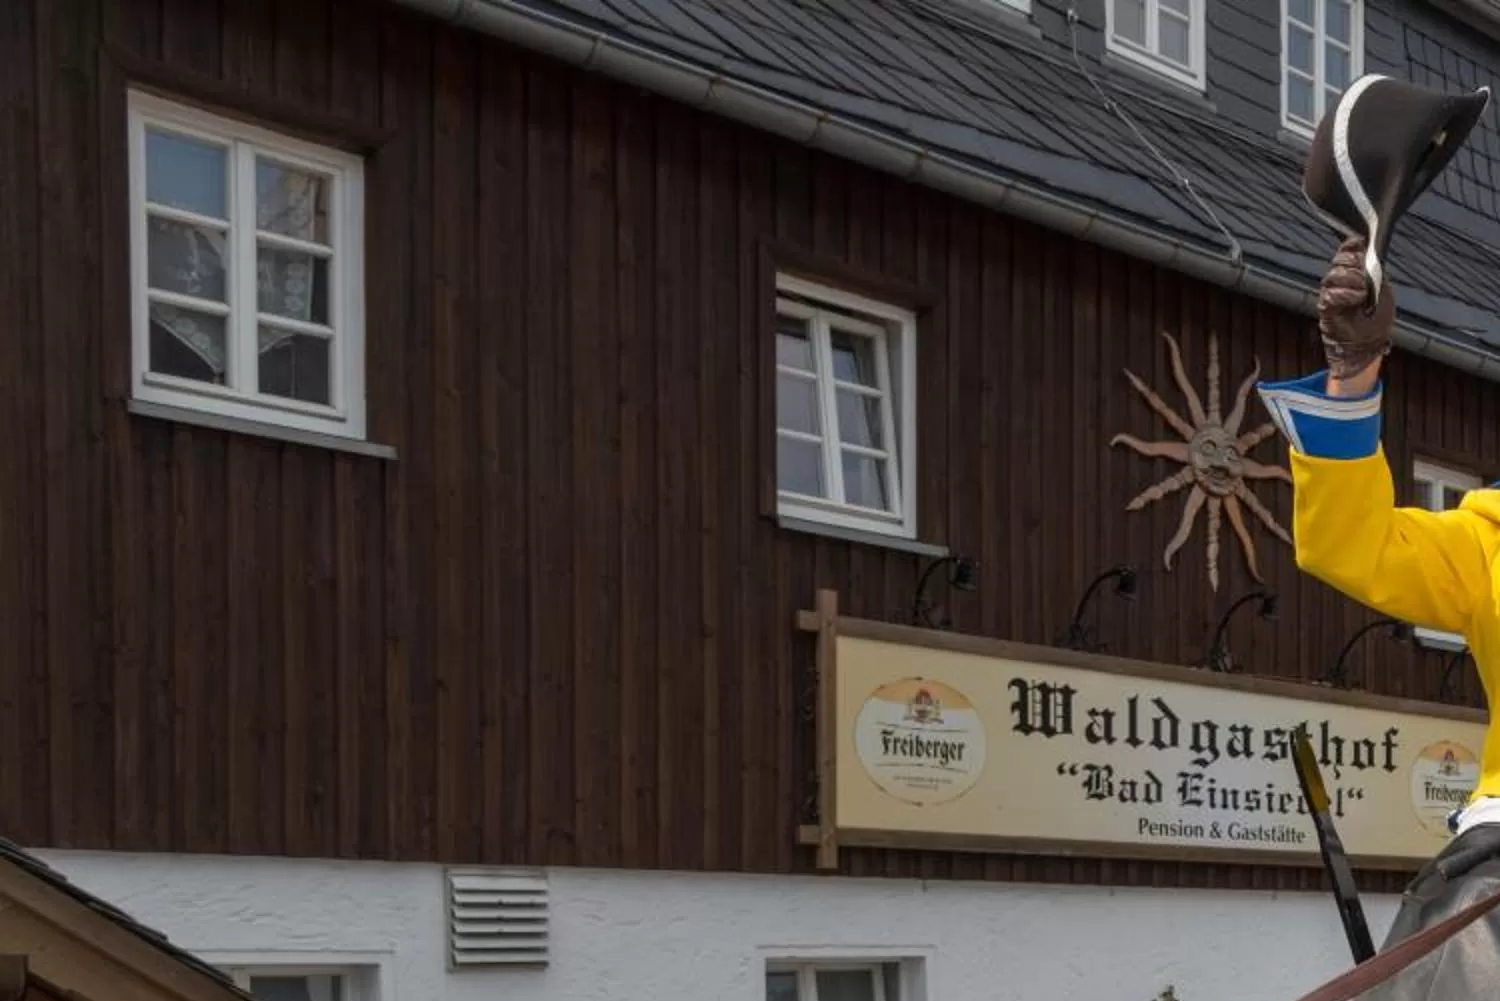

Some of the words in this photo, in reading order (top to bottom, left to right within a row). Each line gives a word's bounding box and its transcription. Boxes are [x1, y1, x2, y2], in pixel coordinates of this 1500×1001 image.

[880, 728, 965, 766] Freiberger
[1138, 817, 1204, 838] Pension
[1209, 821, 1222, 839] &
[1227, 823, 1306, 844] Gaststätte
